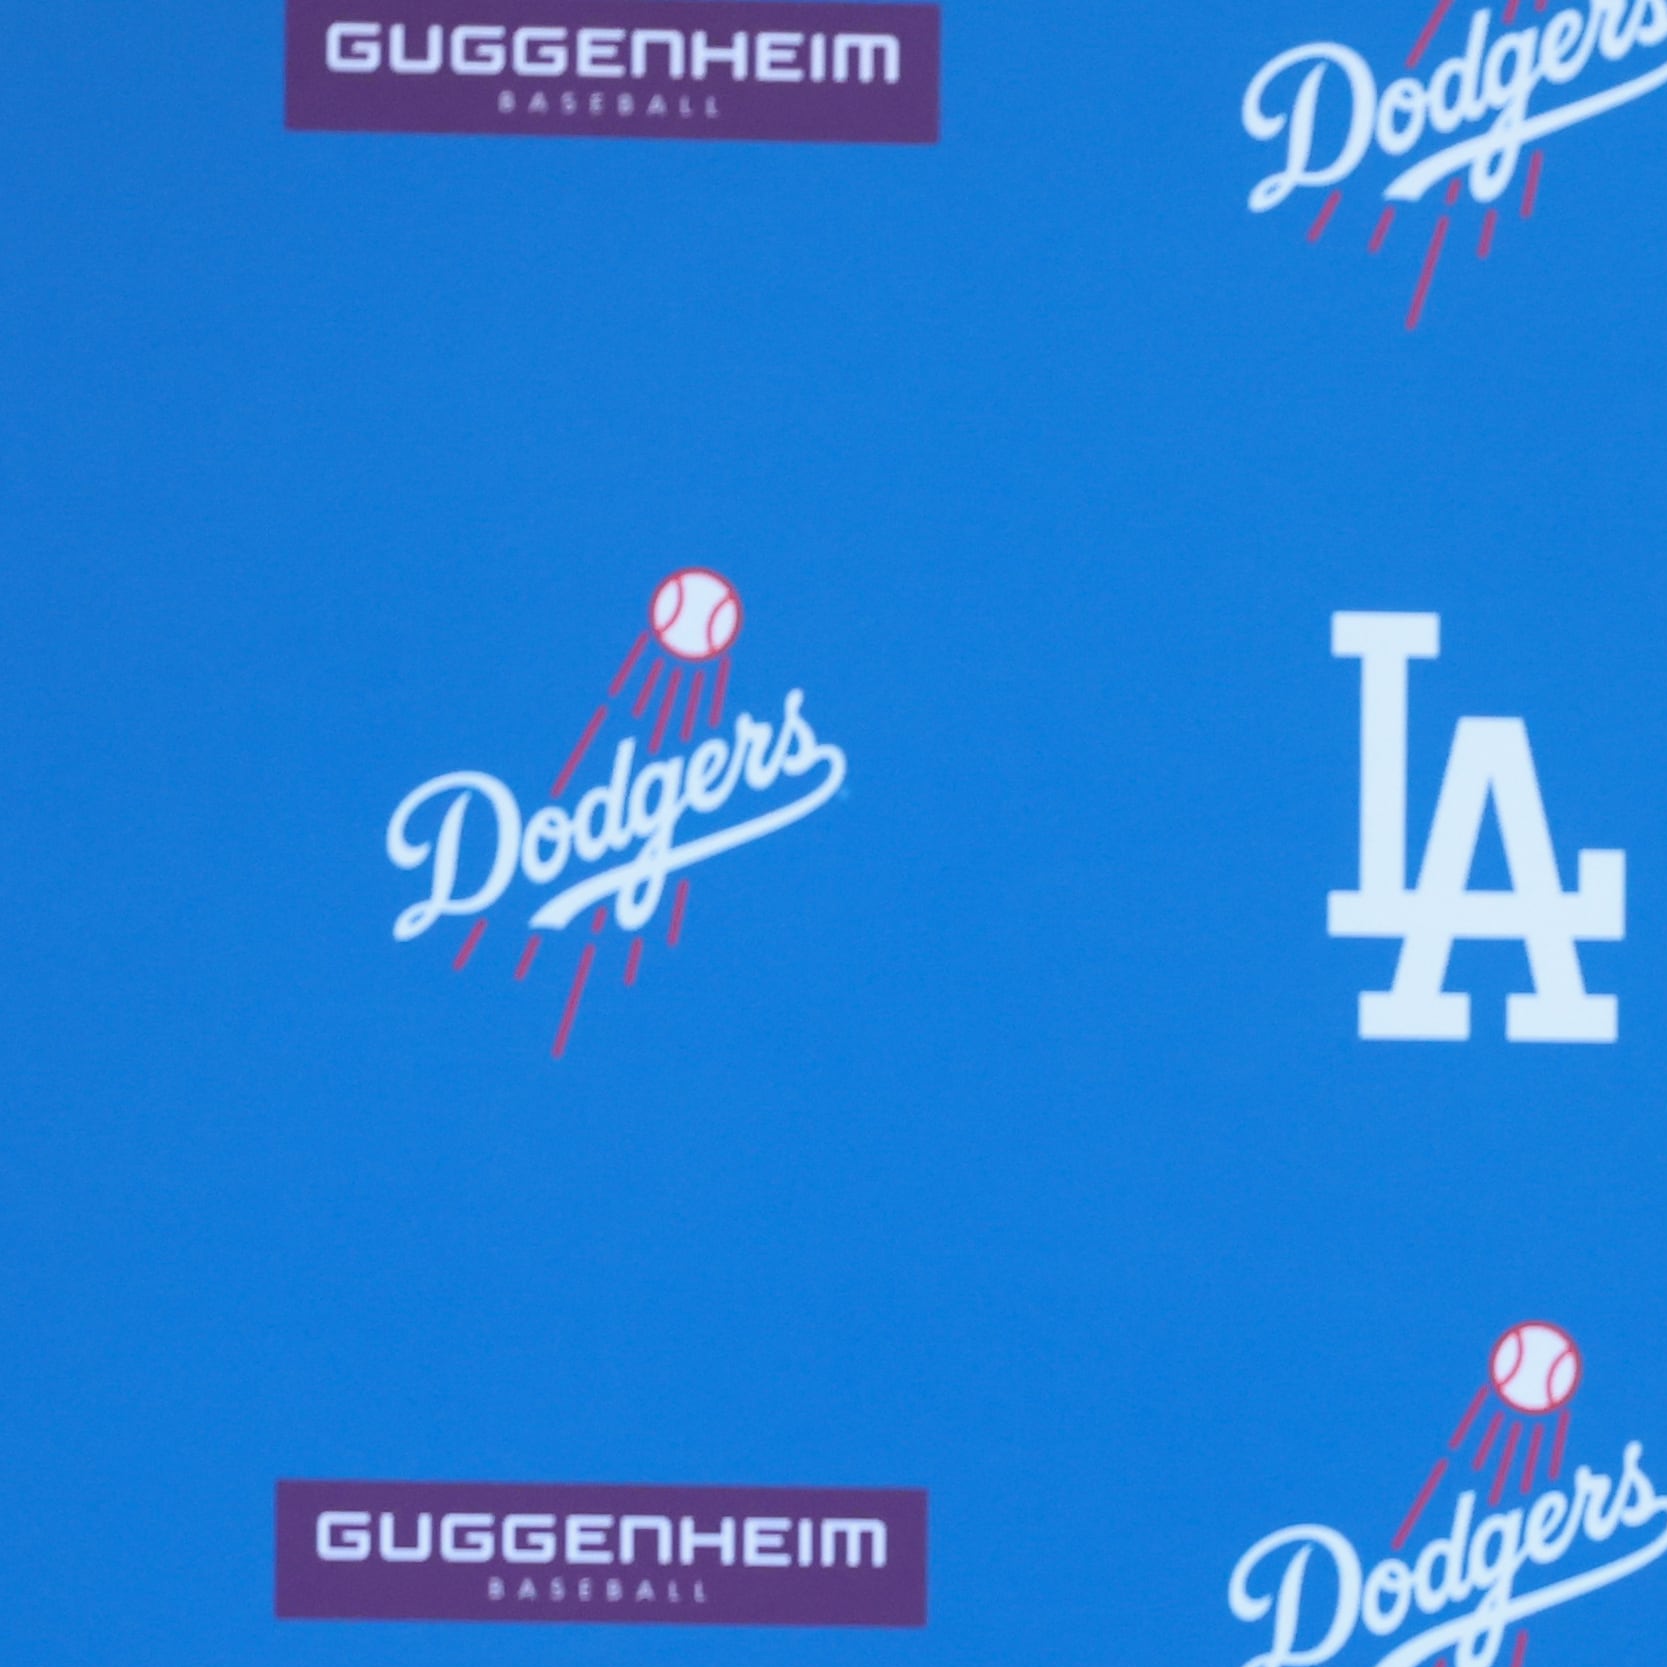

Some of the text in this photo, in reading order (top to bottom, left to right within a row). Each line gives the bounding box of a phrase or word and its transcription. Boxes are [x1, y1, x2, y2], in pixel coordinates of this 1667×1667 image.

[325, 22, 900, 84] GUGGENHEIM
[498, 90, 719, 117] BASEBALL
[387, 689, 846, 940] Dodgers
[1327, 611, 1626, 1043] LA
[316, 1510, 888, 1569] GUGGENHEIM
[487, 1576, 707, 1603] BASEBALL
